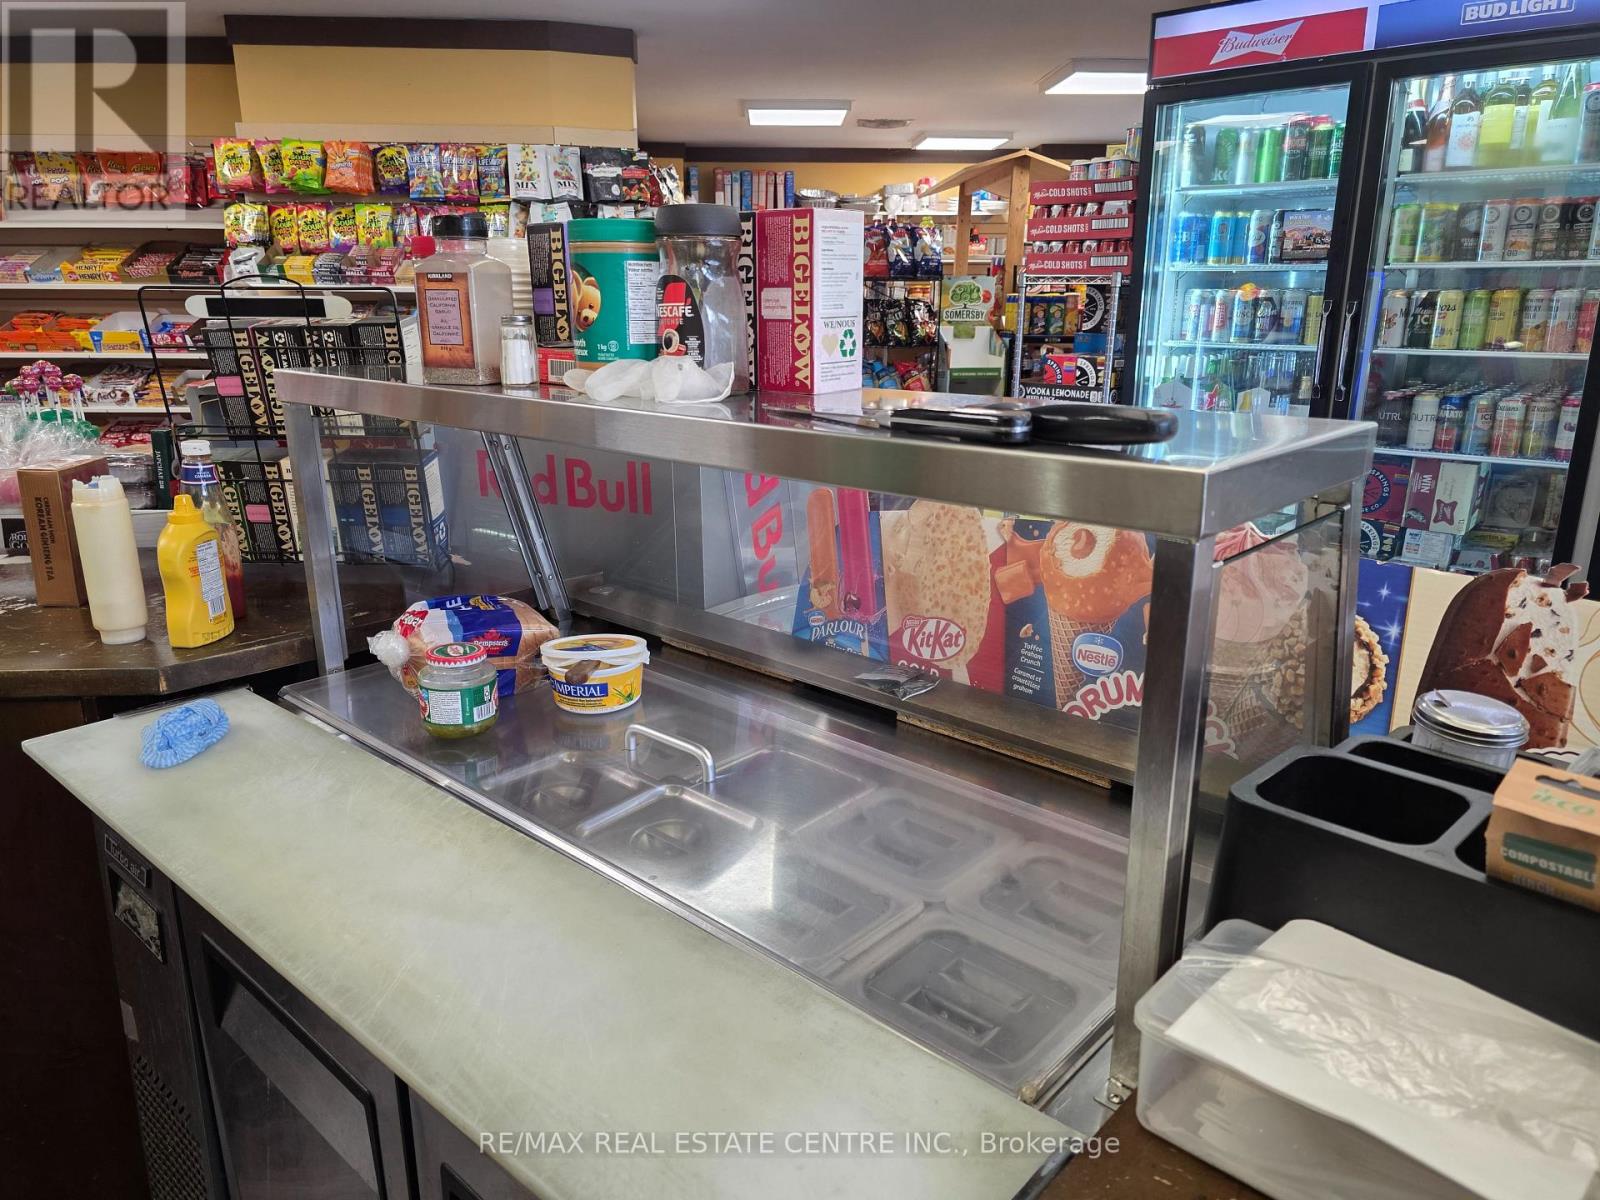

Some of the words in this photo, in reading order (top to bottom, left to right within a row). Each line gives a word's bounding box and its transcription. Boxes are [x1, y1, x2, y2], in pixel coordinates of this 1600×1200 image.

[1464, 5, 1511, 21] BUD
[1219, 31, 1294, 54] Budweiser
[515, 181, 538, 189] MIX
[558, 180, 578, 189] MIX
[1066, 187, 1088, 196] SHOTS
[1063, 223, 1085, 233] SHOTS
[1061, 260, 1083, 269] SHOTS
[550, 227, 570, 342] BIGELO
[792, 213, 811, 390] BIGELOW
[944, 310, 985, 320] SOMERSBY
[232, 330, 271, 435] BIGELOW
[1026, 387, 1050, 397] VODKA
[1051, 388, 1090, 399] LEMONADE
[476, 449, 558, 506] Rd
[565, 457, 653, 515] Bull
[1420, 474, 1432, 494] WIN
[264, 463, 297, 561] BIGELOW
[357, 466, 387, 562] BIGELOW
[403, 465, 432, 562] BIGELOW
[35, 497, 47, 531] KOREAN
[45, 565, 55, 581] TEA
[811, 620, 864, 642] PARLOUR
[907, 620, 962, 659] KitKat
[1021, 648, 1043, 660] Graham
[1023, 642, 1043, 653] Toffee
[1020, 656, 1041, 667] Crunch
[554, 680, 607, 697] IMPERIAL
[110, 838, 129, 869] Turbo
[130, 863, 140, 878] air
